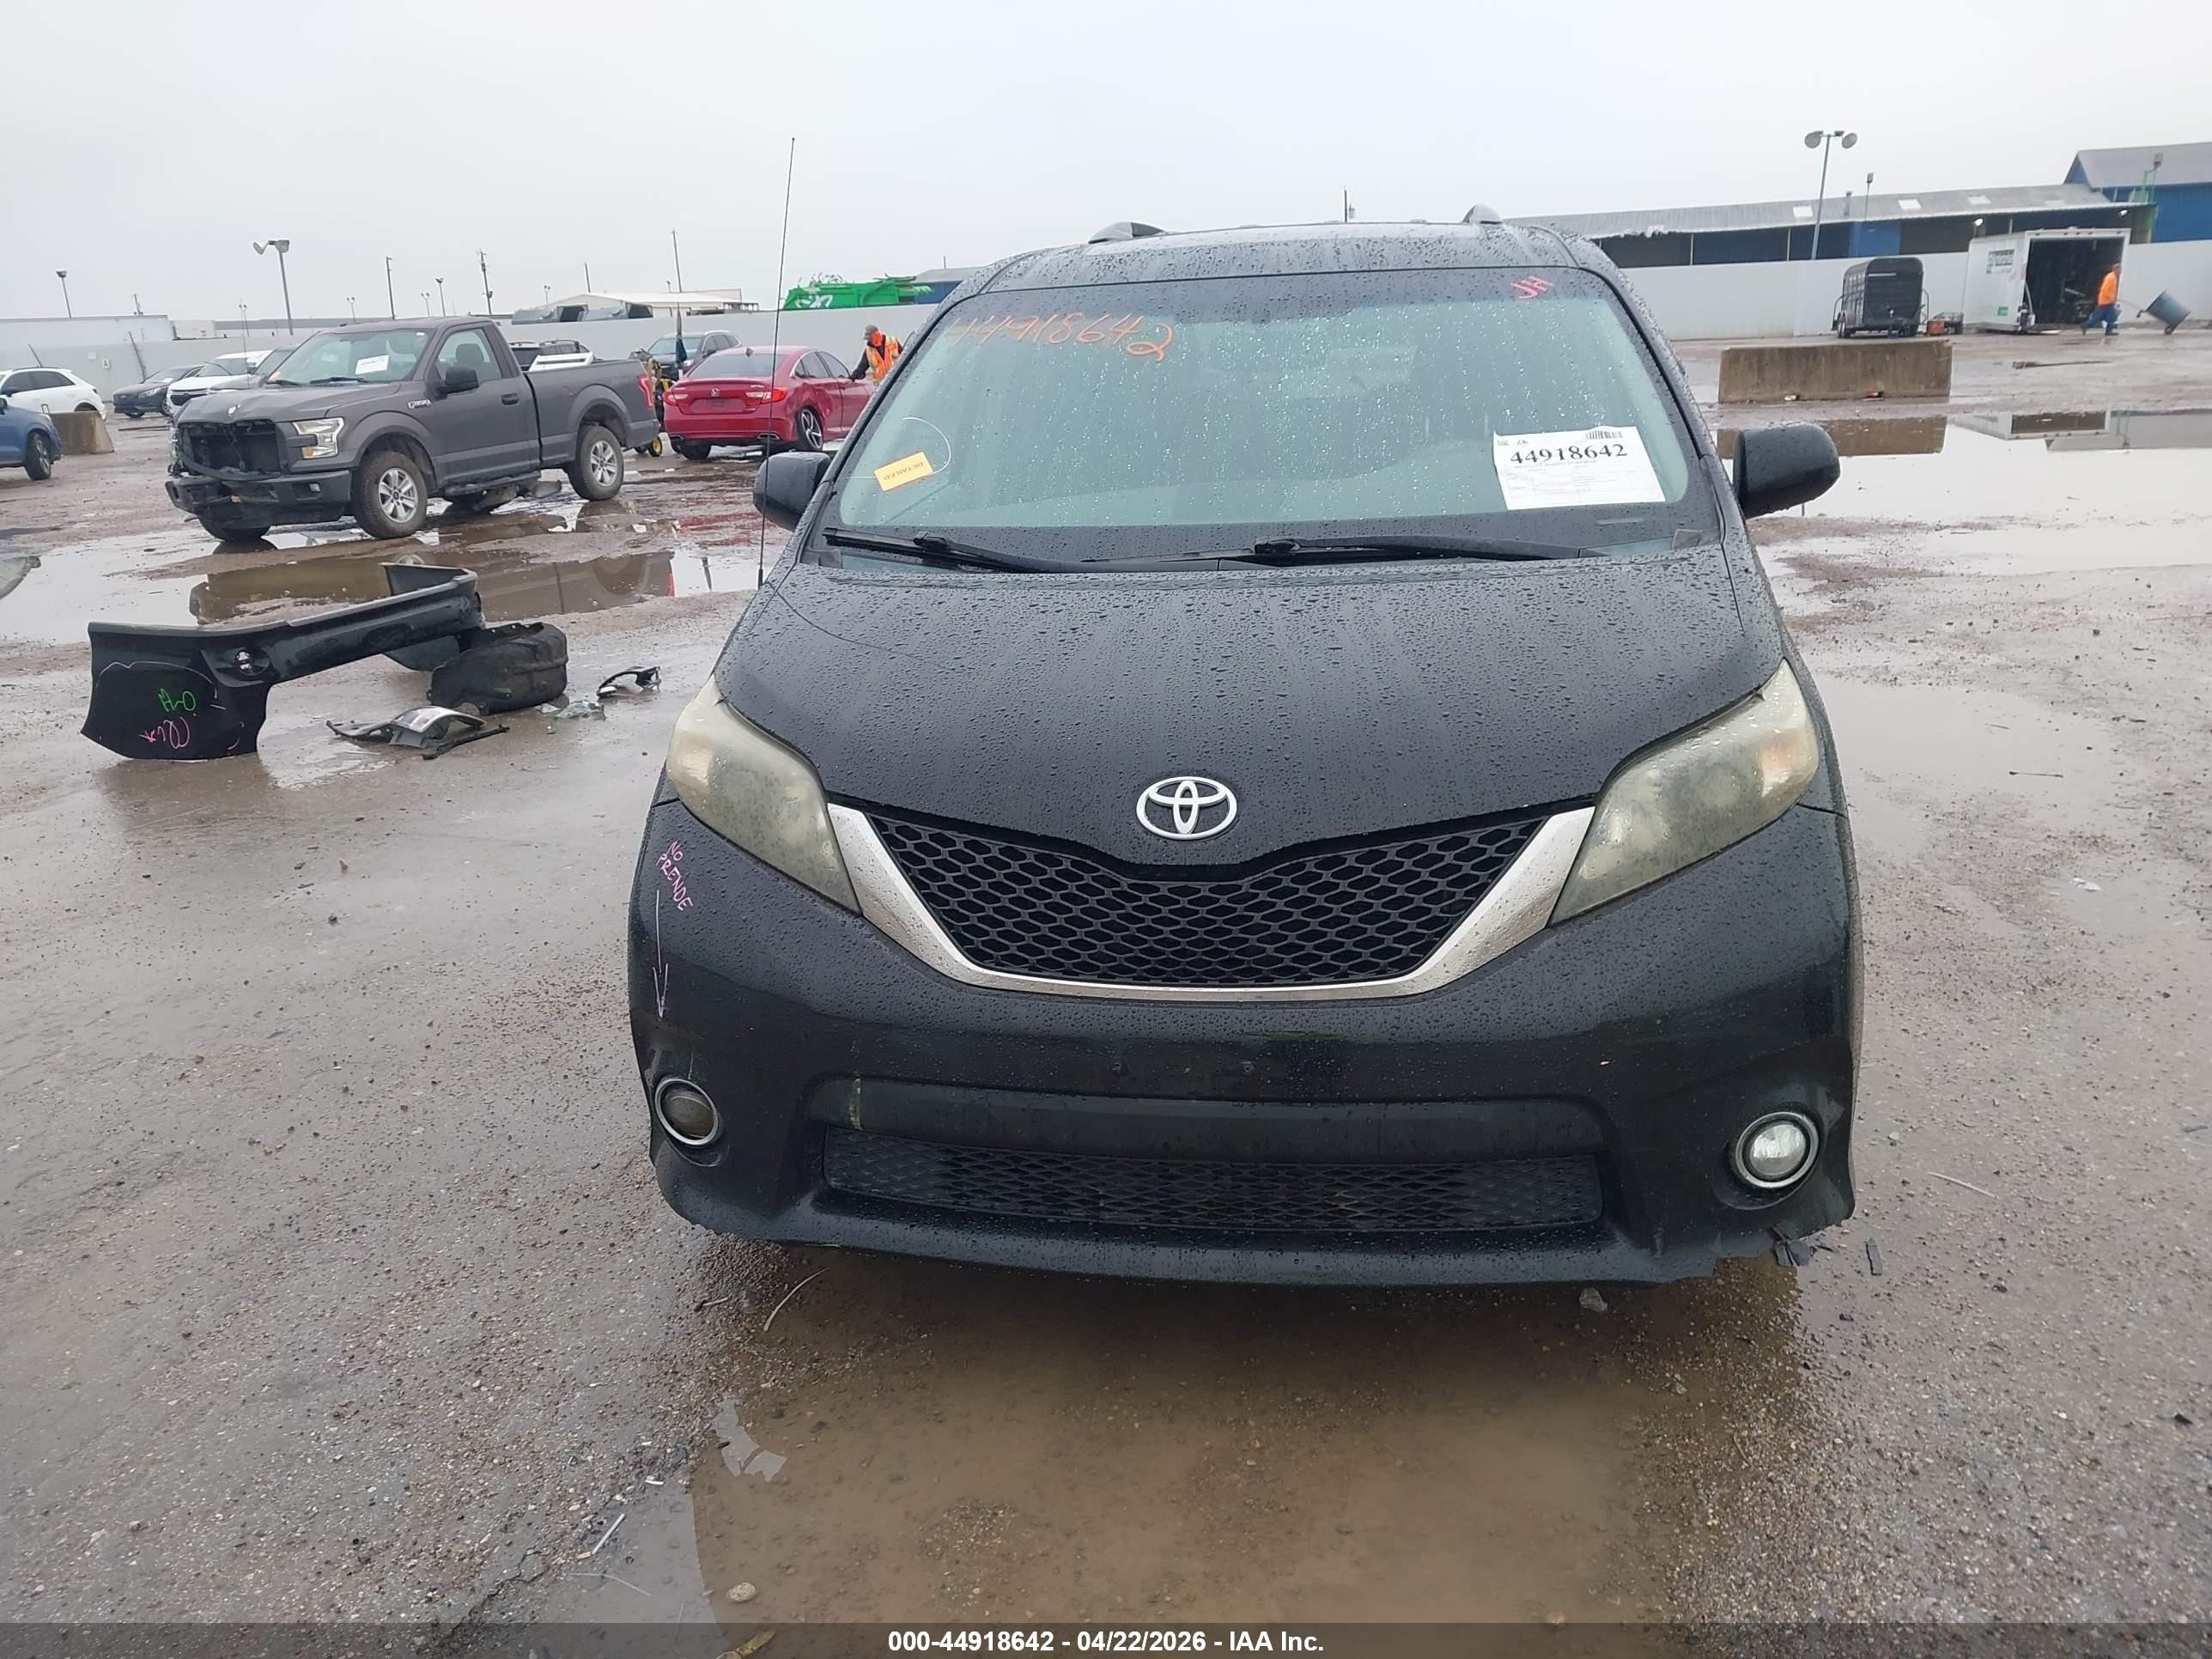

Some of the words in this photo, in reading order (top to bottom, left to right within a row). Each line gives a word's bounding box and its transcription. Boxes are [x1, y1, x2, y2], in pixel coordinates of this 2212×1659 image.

[945, 313, 1174, 362] 44918642
[1510, 443, 1628, 464] 44918642
[884, 461, 924, 480] DETAILED
[667, 841, 684, 861] NO
[655, 854, 694, 911] PRENDE
